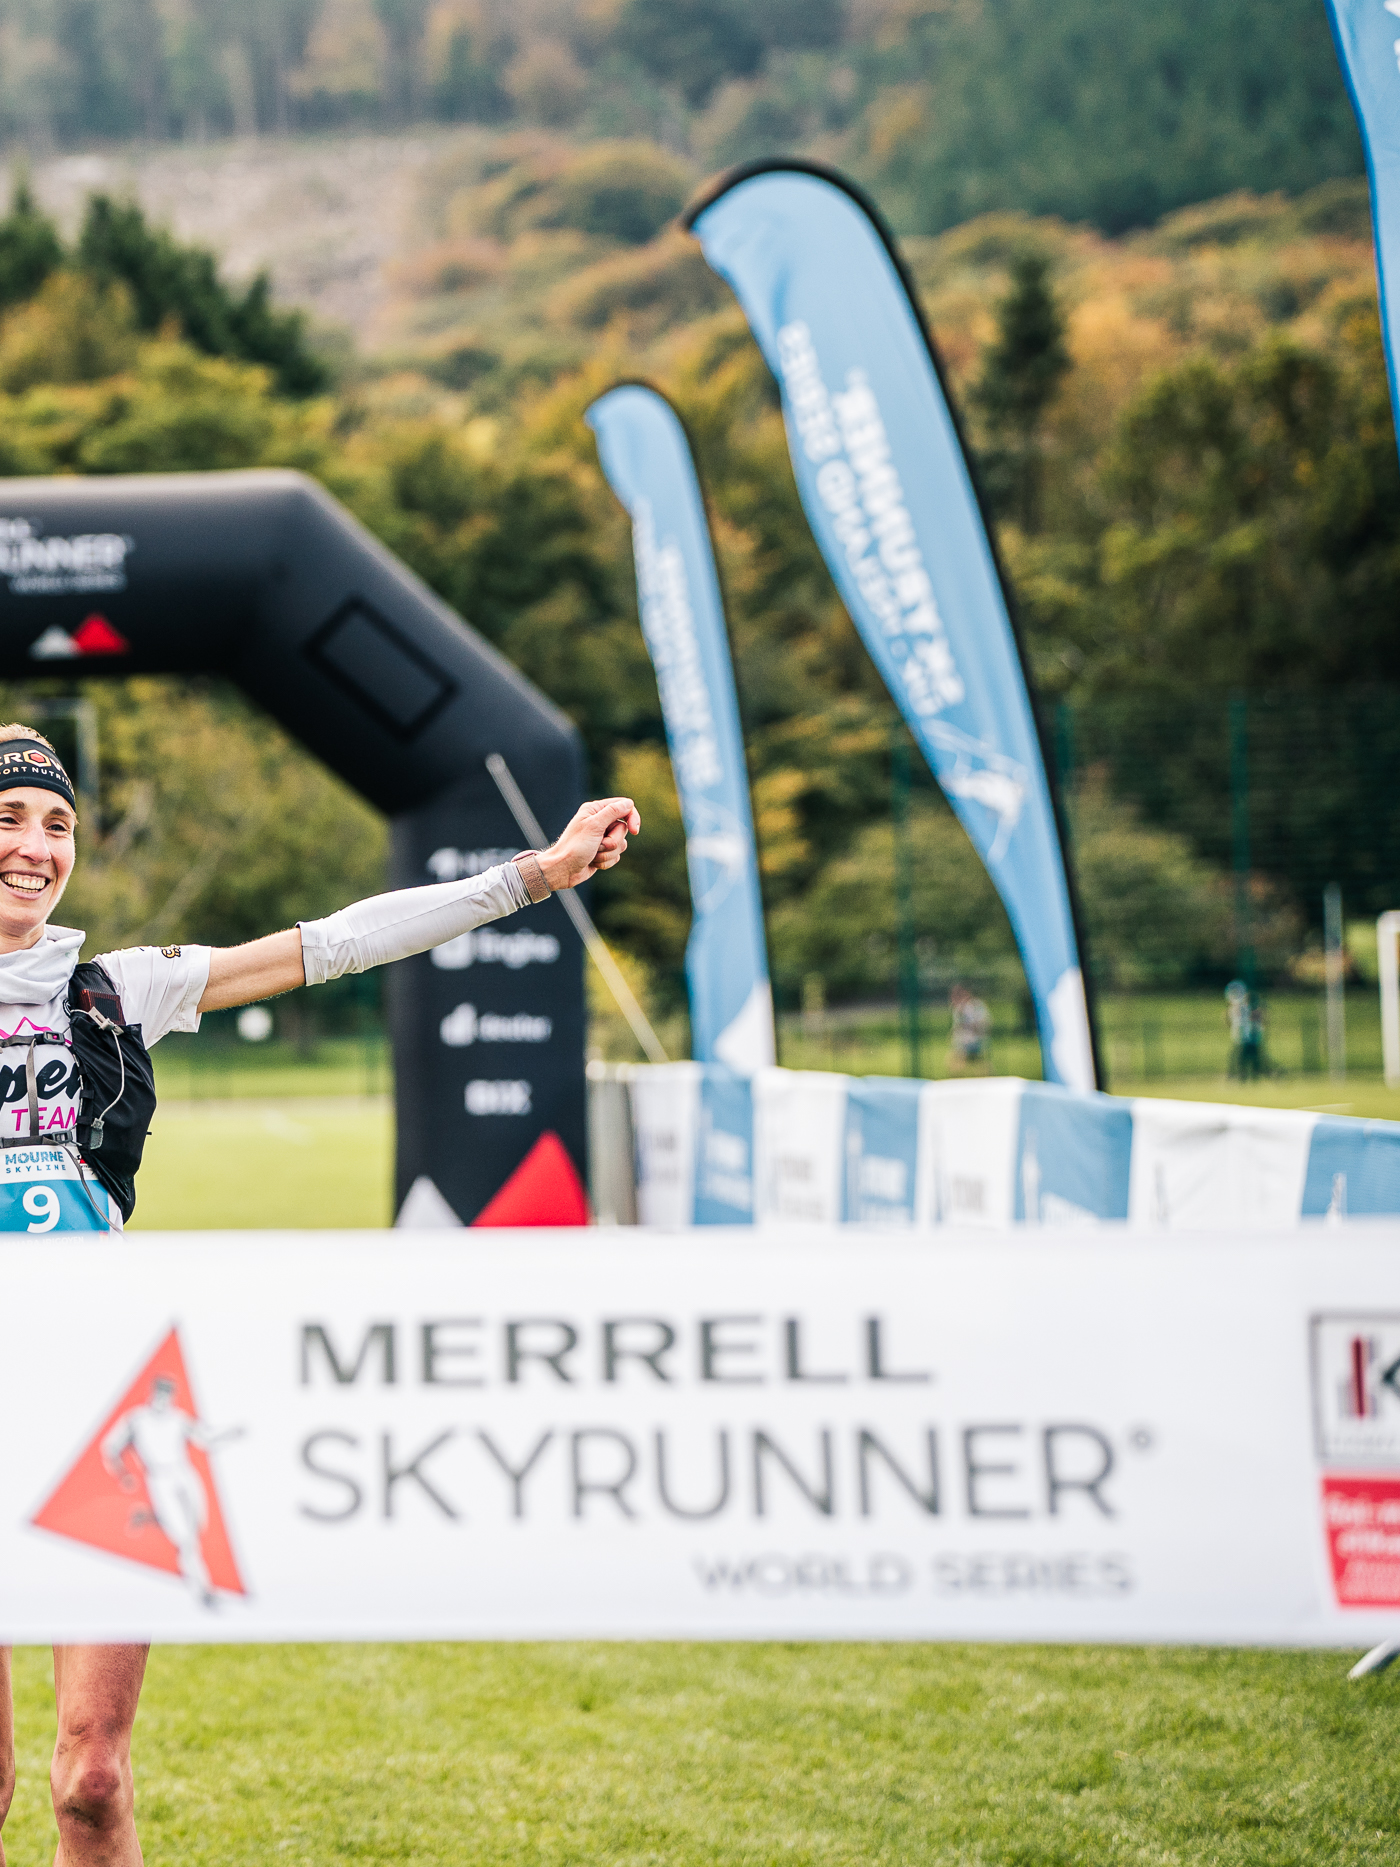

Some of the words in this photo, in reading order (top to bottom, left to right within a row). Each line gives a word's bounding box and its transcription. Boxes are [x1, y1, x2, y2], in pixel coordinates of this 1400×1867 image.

[5, 1151, 64, 1165] MOURNE
[6, 1164, 67, 1174] SKYLINE
[22, 1185, 60, 1234] 9
[300, 1315, 934, 1387] MERRELL
[694, 1553, 910, 1598] WORLD
[933, 1550, 1135, 1598] SERIES
